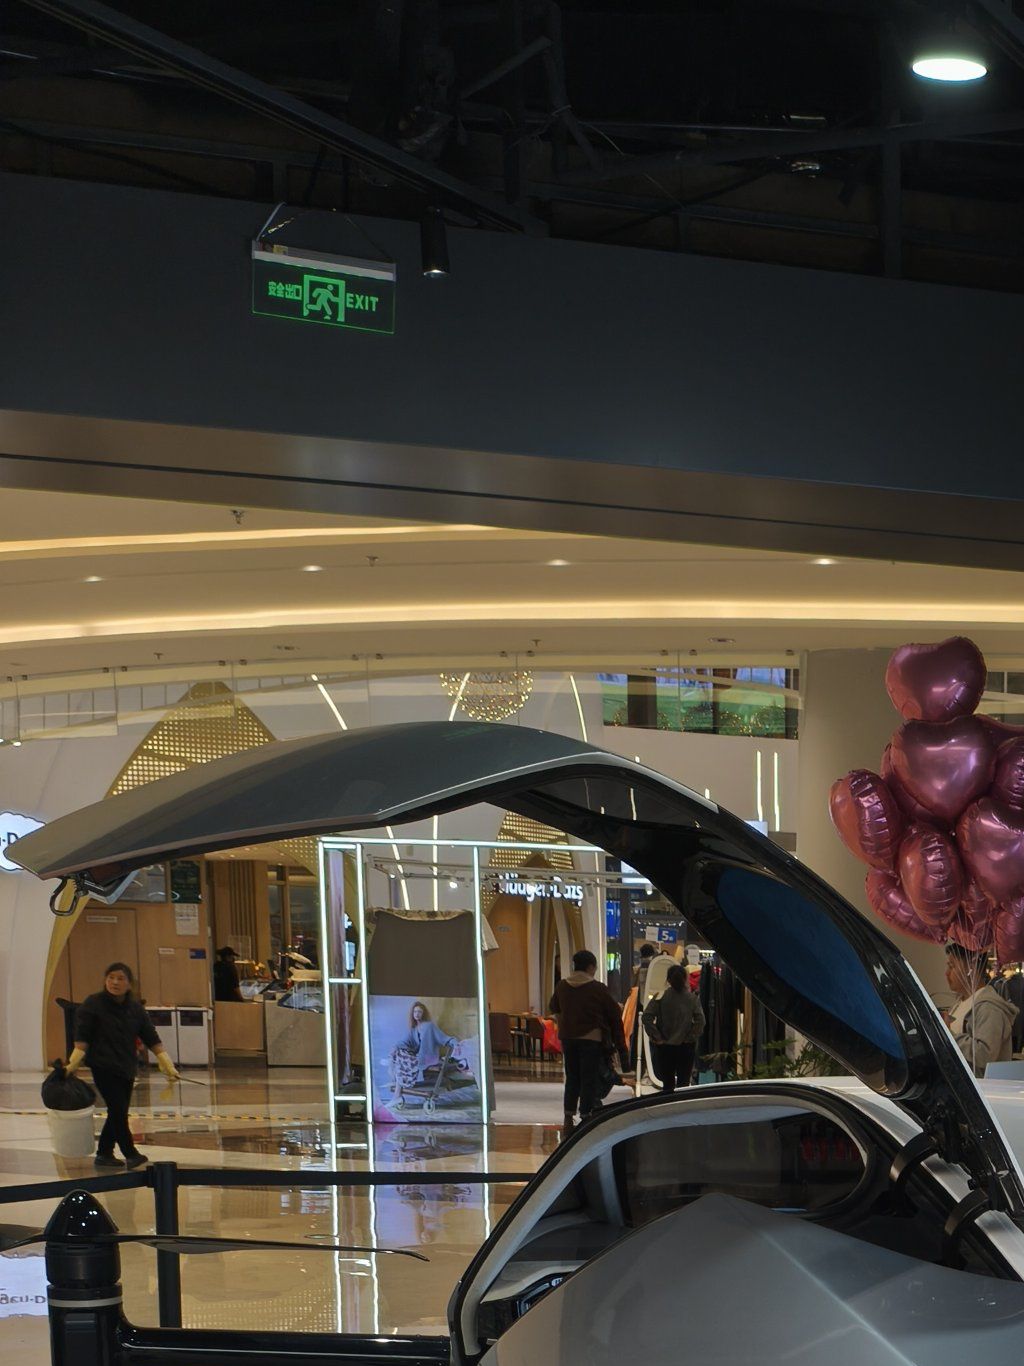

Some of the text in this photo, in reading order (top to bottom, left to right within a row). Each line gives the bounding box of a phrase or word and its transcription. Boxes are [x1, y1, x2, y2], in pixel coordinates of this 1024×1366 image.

[268, 281, 302, 301] 安全出口
[346, 293, 379, 312] EXIT
